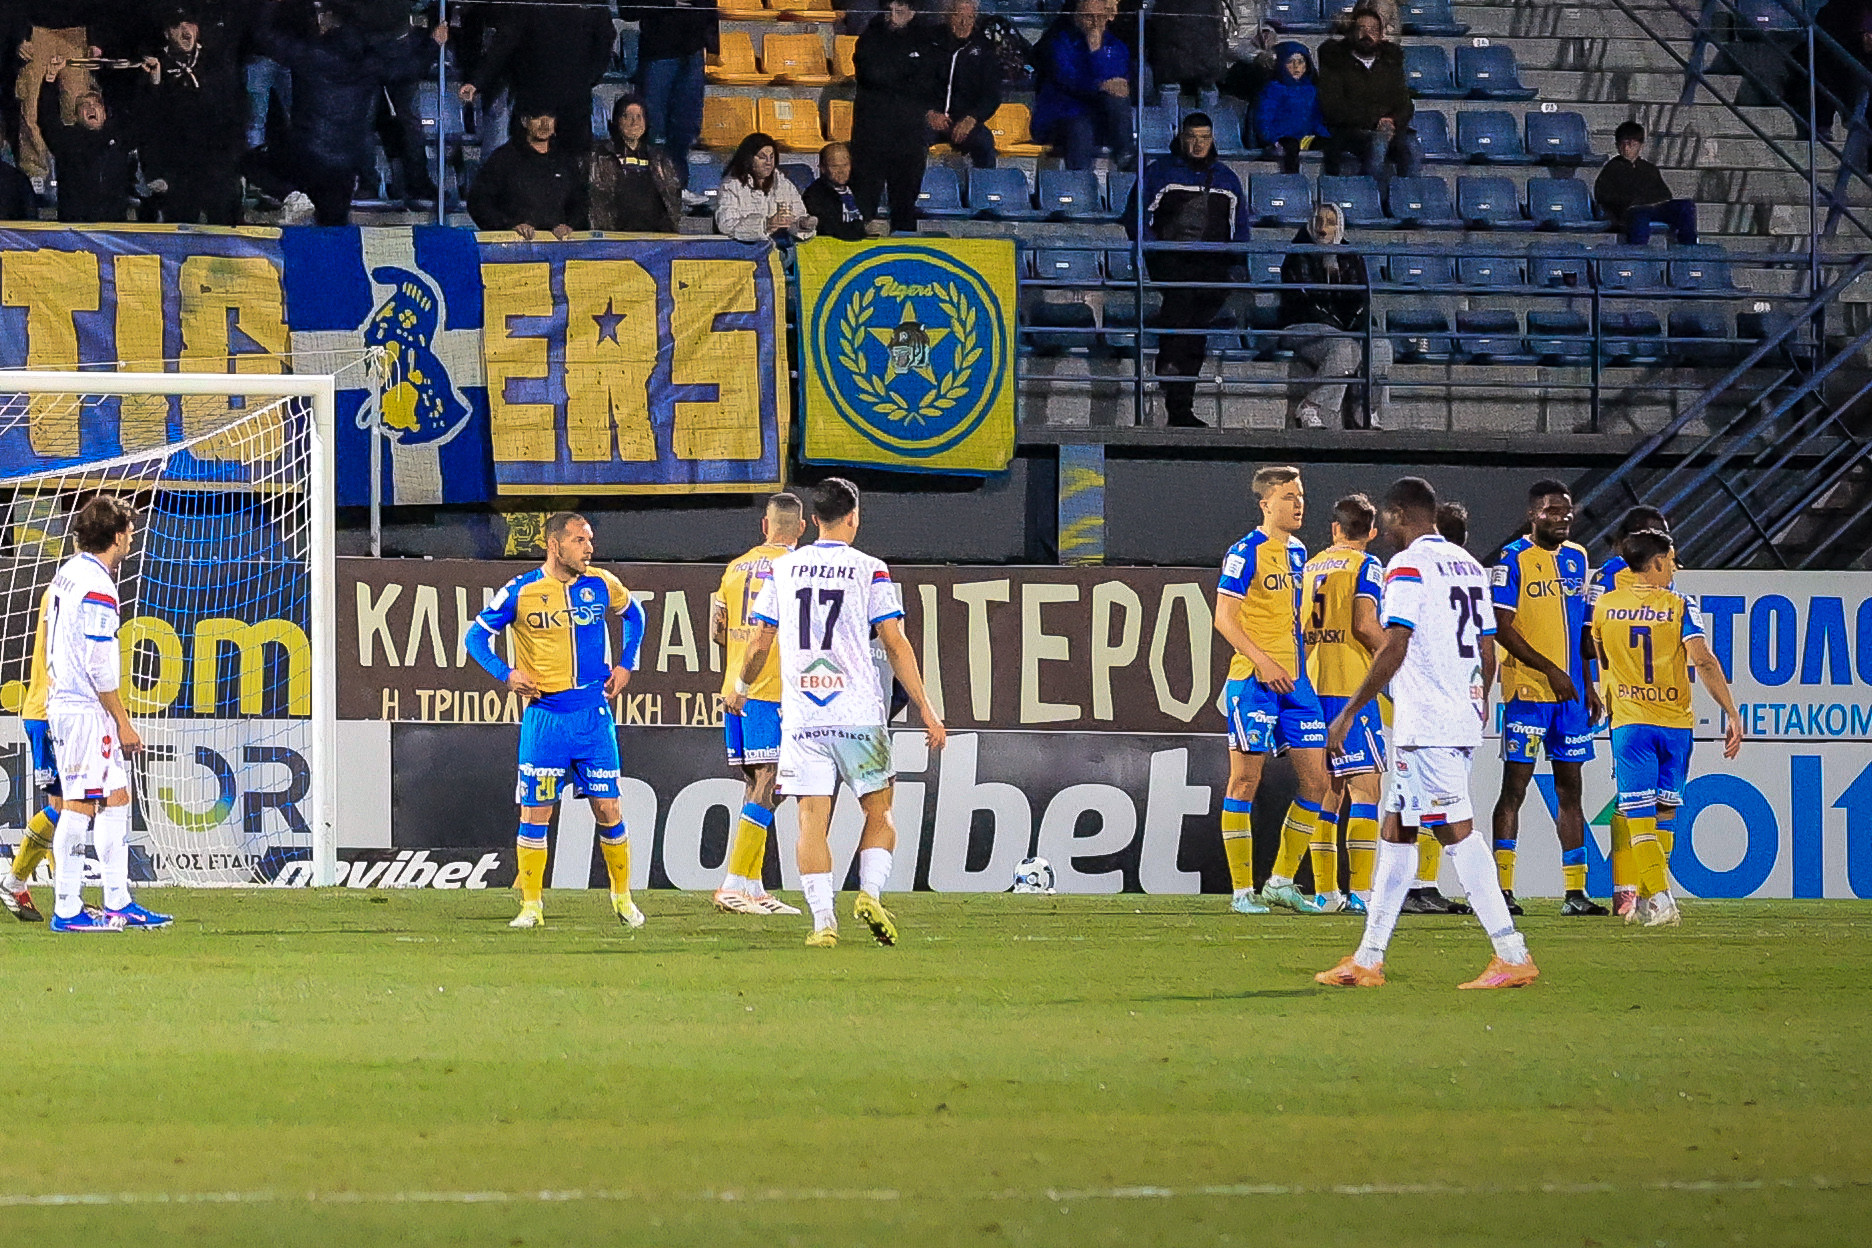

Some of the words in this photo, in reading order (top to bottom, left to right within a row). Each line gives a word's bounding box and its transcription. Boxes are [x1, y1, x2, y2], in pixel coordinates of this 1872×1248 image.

[795, 587, 845, 650] 17
[1449, 586, 1484, 659] 25
[1606, 605, 1675, 622] novibet
[800, 674, 846, 690] ΕΒΟΛ
[1629, 625, 1654, 684] 7
